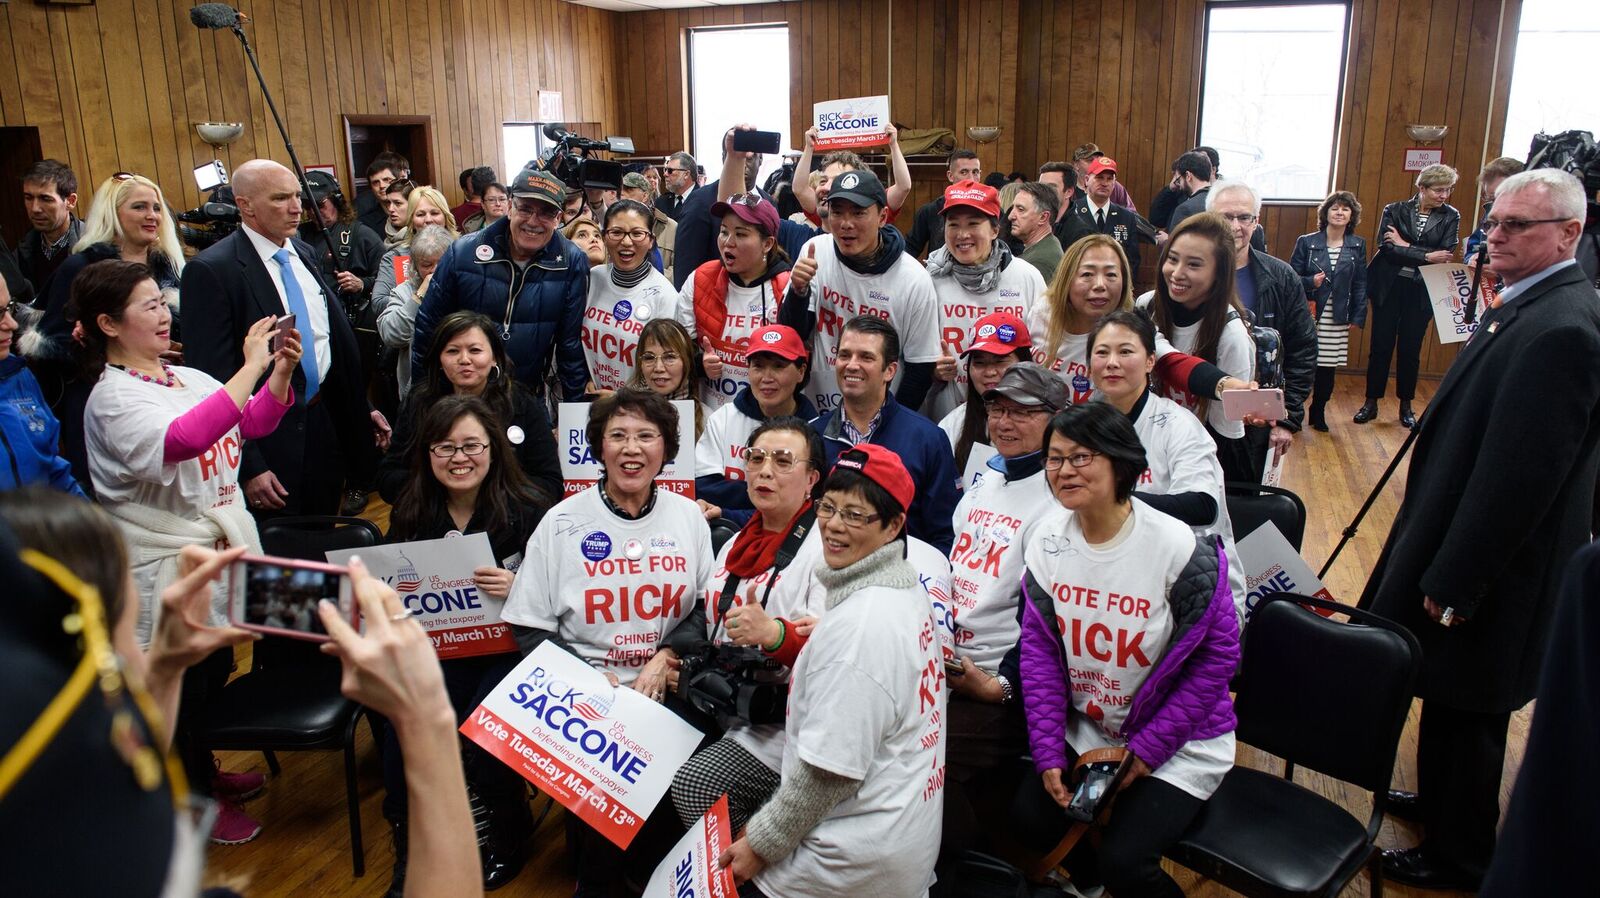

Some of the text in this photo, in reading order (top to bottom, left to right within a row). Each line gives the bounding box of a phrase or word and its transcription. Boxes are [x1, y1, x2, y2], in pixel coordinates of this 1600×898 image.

[819, 112, 841, 122] RICK
[819, 117, 878, 132] SACCONE
[832, 136, 856, 145] Tuesday
[857, 134, 876, 142] March
[823, 286, 854, 313] VOTE
[944, 304, 987, 318] VOTE
[1452, 308, 1467, 335] RICK
[581, 326, 638, 367] RICK
[1031, 347, 1064, 371] VOE
[816, 393, 842, 408] RIC
[569, 429, 588, 445] RI
[563, 482, 587, 492] Vote
[672, 482, 690, 492] 13th
[968, 508, 993, 527] VOTE
[584, 555, 687, 577] VOTE FOR
[1247, 563, 1282, 589] CONGRESS
[431, 578, 476, 590] CONGRESS
[404, 587, 482, 616] CONE
[584, 583, 687, 625] RICK
[1107, 592, 1151, 619] FOR
[436, 618, 448, 626] the
[450, 614, 485, 624] taxpayer
[443, 629, 485, 644] March
[485, 626, 509, 639] 13th
[526, 667, 584, 709] RICK
[509, 683, 647, 784] SACCONE
[614, 721, 627, 732] US
[608, 728, 654, 762] CONGRESS
[477, 710, 636, 826] Vote Tuesday March 13th
[532, 726, 629, 797] Defending the taxpayer
[709, 830, 721, 873] March
